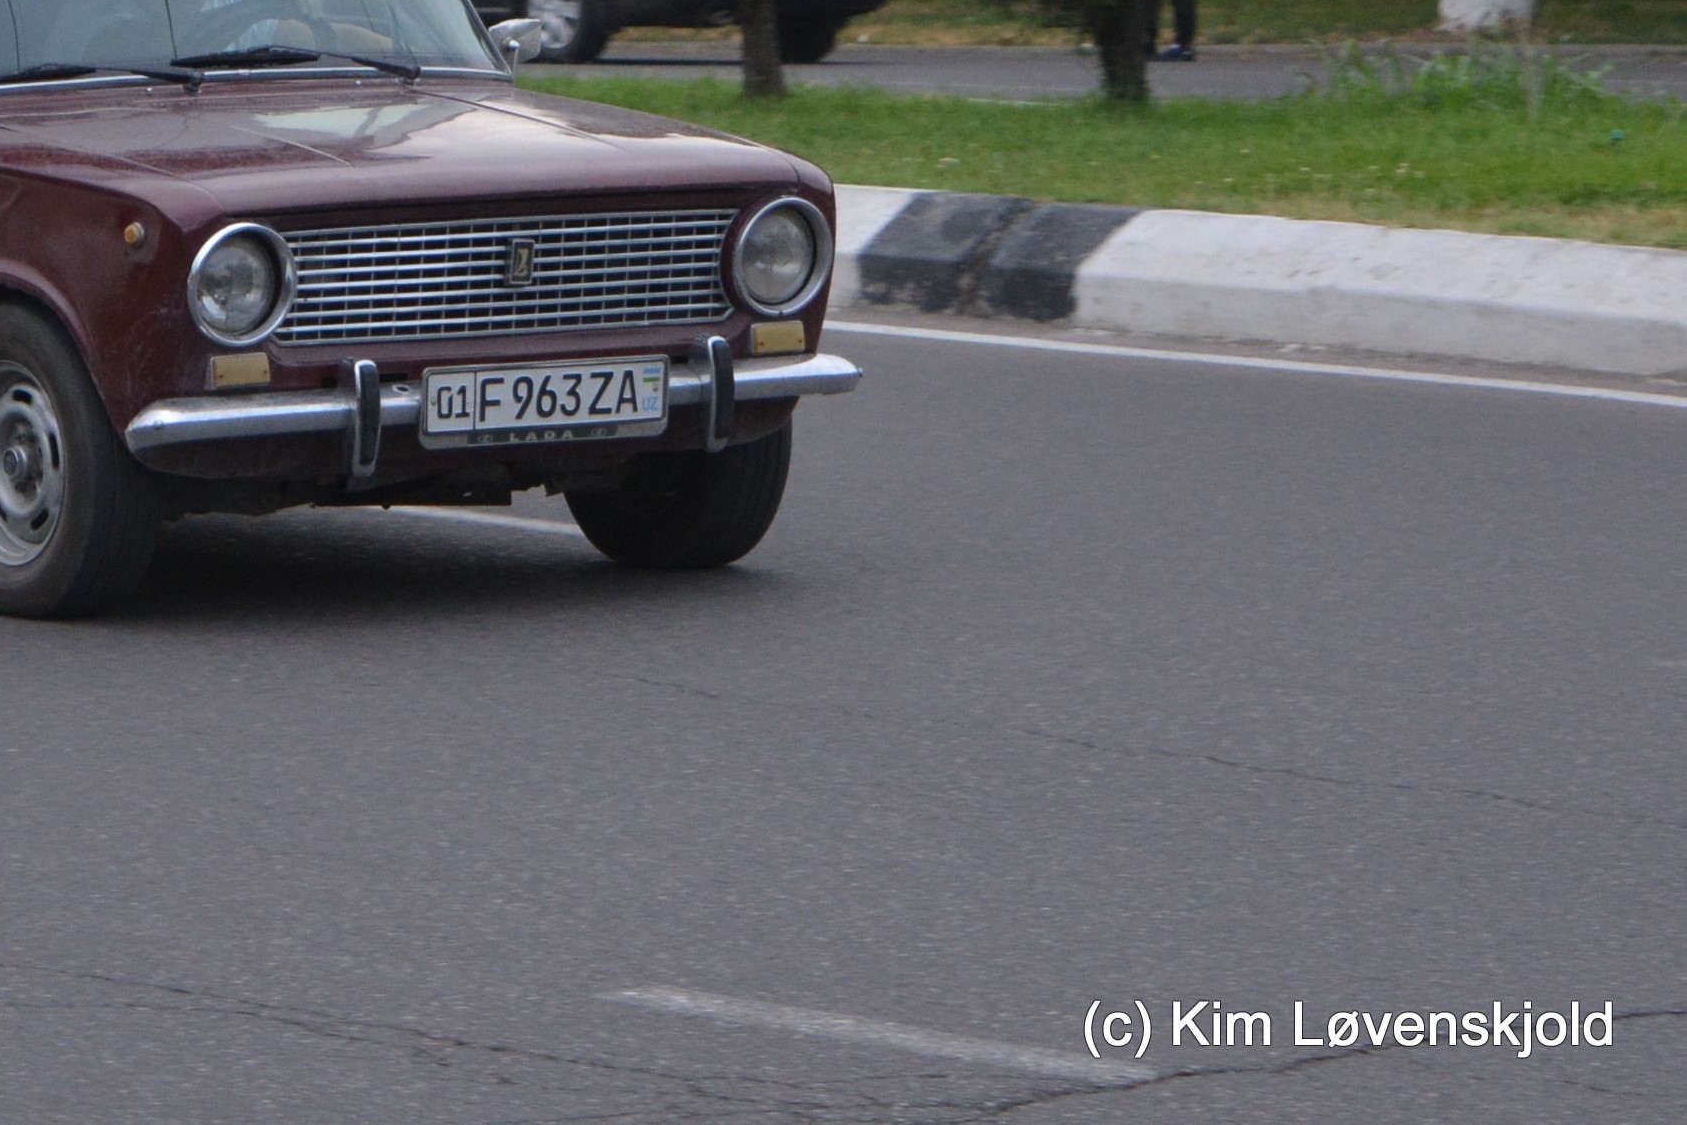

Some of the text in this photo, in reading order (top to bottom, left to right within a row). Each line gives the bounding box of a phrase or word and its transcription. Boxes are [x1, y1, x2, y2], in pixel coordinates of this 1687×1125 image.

[436, 385, 470, 419] 01
[642, 395, 659, 412] UZ
[509, 429, 575, 443] LADA
